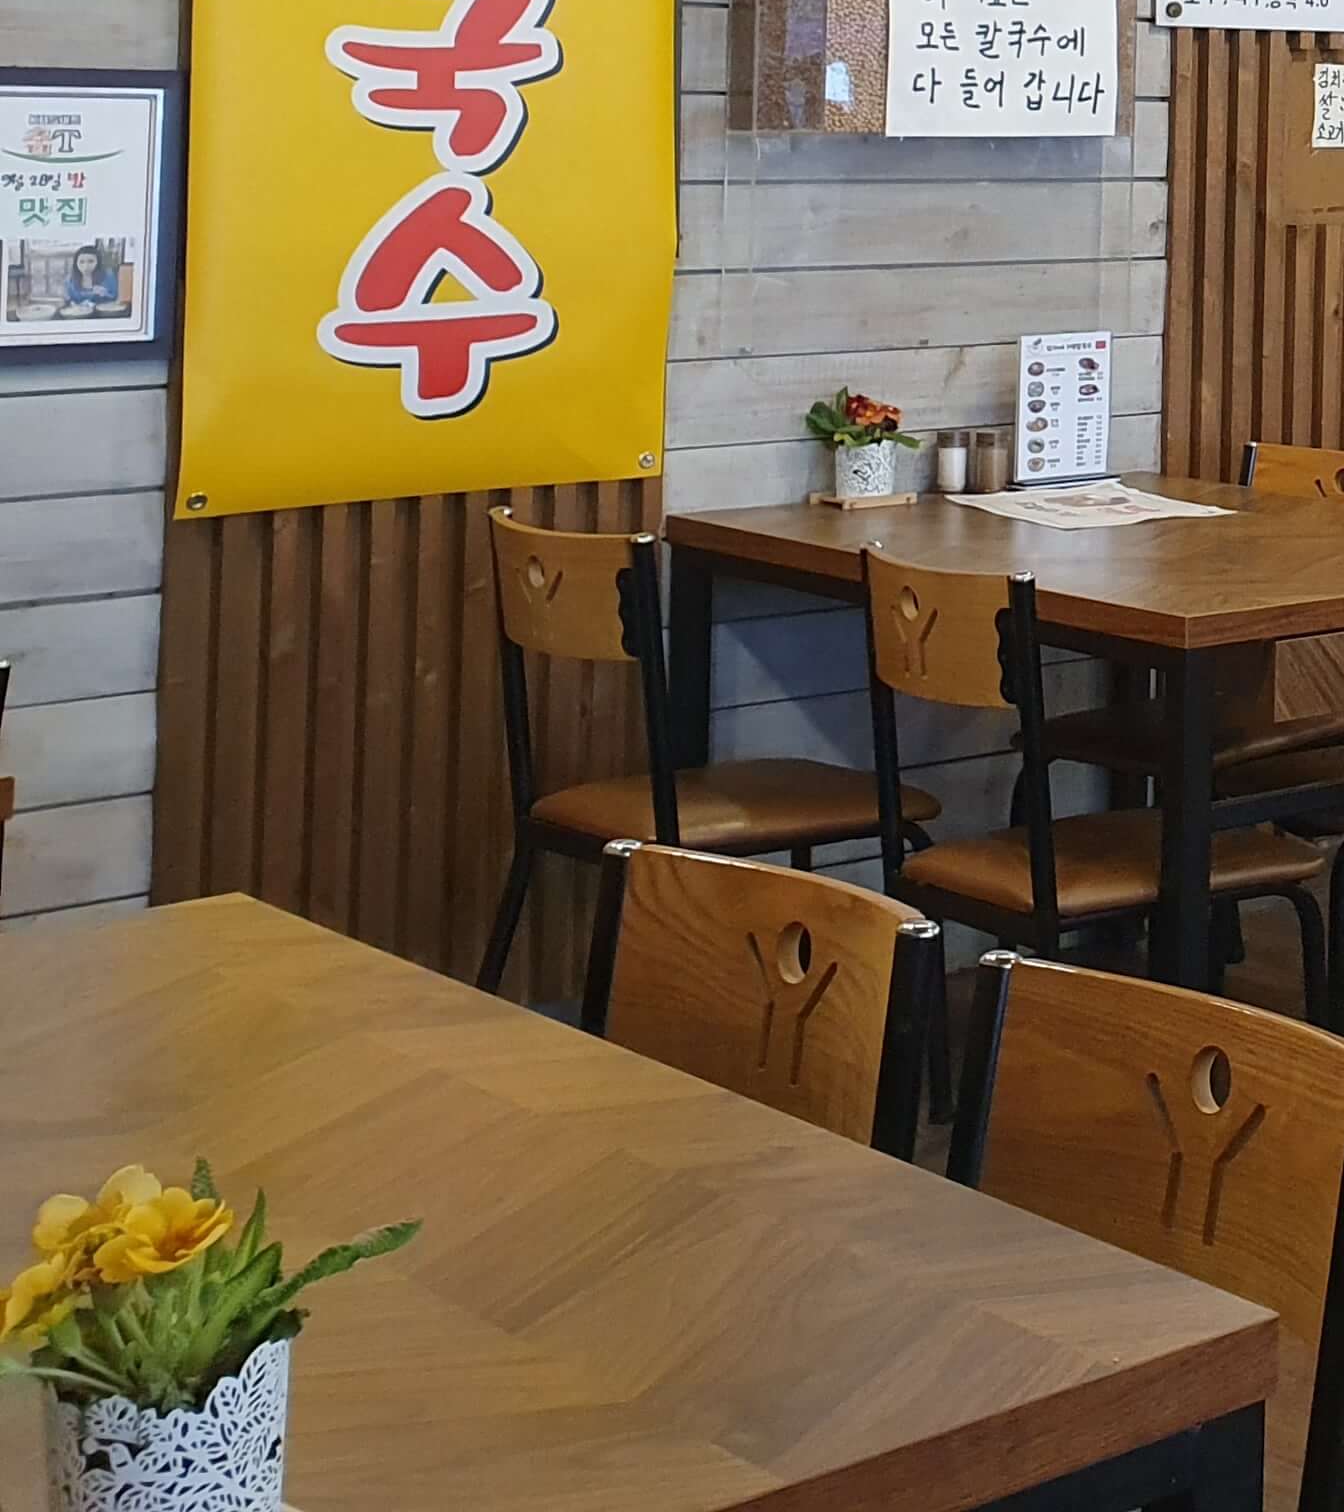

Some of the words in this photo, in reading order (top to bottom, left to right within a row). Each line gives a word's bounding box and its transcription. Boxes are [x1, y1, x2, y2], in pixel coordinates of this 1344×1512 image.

[916, 21, 960, 53] 모든
[975, 20, 1086, 59] 칼국수에
[912, 68, 942, 105] 다
[959, 68, 1005, 110] 들어
[1022, 70, 1105, 115] 갑니다
